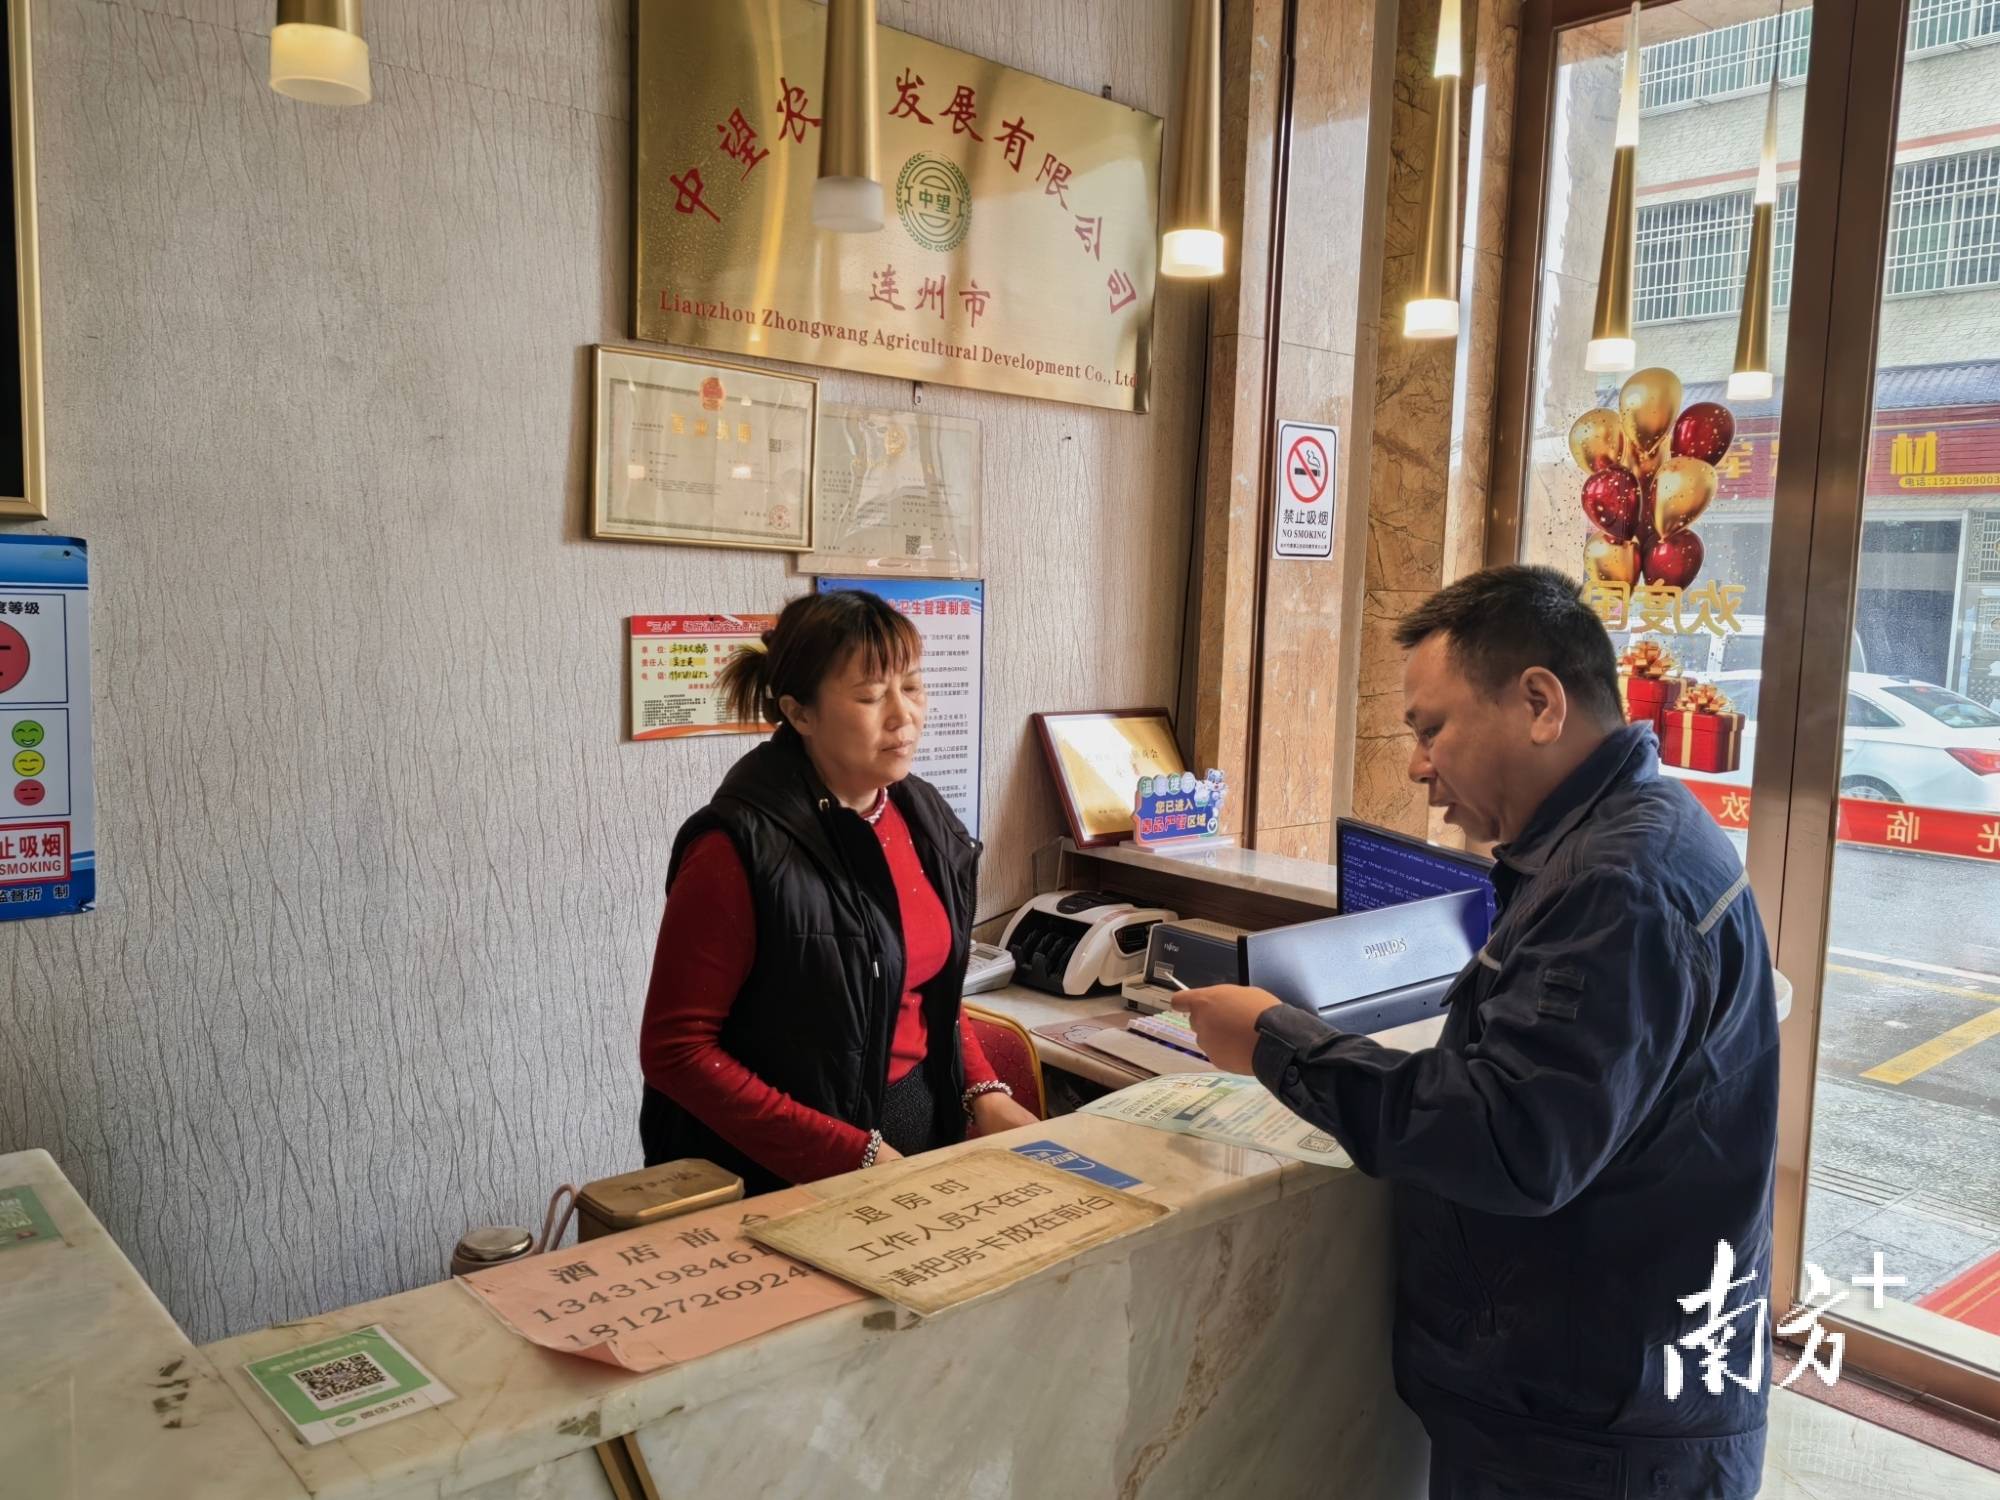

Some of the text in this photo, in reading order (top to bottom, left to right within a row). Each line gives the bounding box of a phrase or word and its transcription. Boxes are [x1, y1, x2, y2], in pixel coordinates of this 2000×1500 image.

[669, 67, 1136, 314] 中望农发展有限公司
[919, 188, 951, 214] 中望
[869, 263, 990, 328] 连州市
[660, 290, 756, 325] Lianzhou
[762, 308, 868, 346] Zhongwang
[873, 328, 977, 361] Agricultural
[982, 346, 1081, 379] Development
[1283, 509, 1329, 525] 禁止吸烟
[1282, 528, 1327, 540] NO SMOKING
[1155, 798, 1194, 814] 您已进入
[0, 834, 61, 859] 止吸烟
[0, 859, 61, 876] SMOKING
[1363, 937, 1407, 960] PHILIPS
[846, 1178, 970, 1226] 退房时
[847, 1182, 1054, 1262] 工作人员不在时
[880, 1195, 1115, 1288] 请把房卡放在前台
